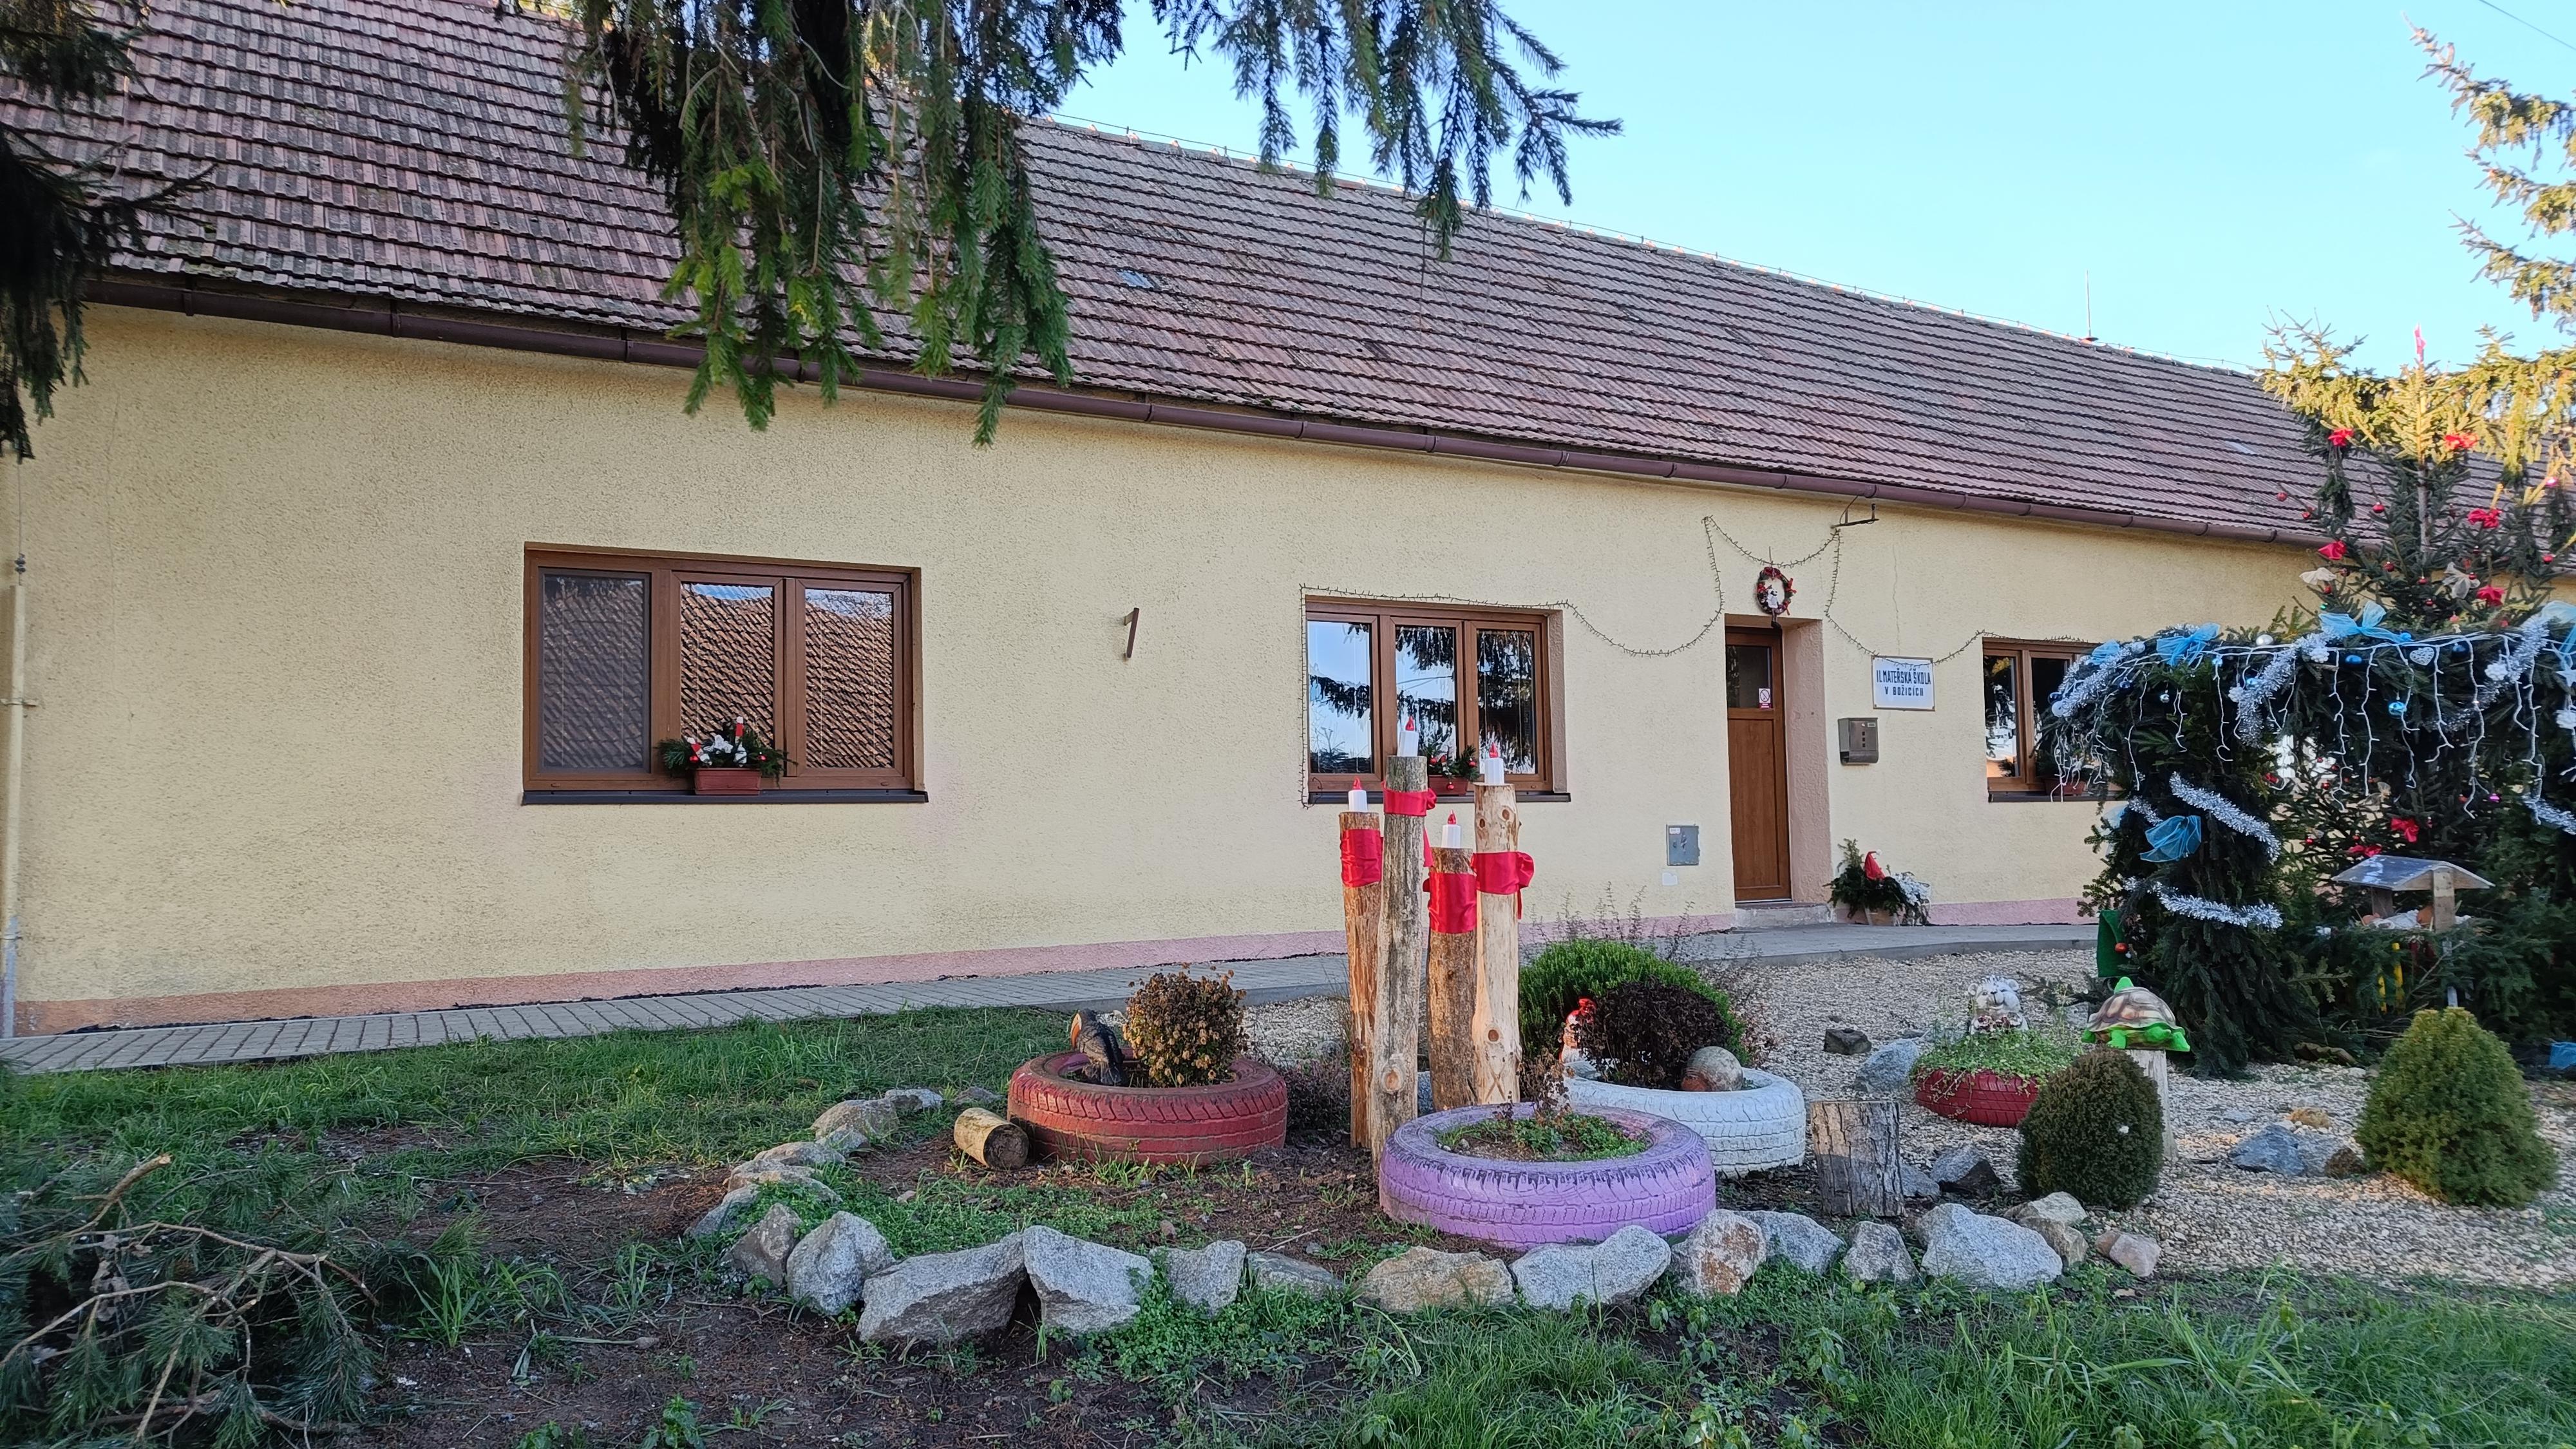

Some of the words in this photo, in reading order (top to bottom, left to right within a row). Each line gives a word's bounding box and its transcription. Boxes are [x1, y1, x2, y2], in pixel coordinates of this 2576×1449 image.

[1883, 668, 1912, 684] MATEŘSKÁ
[1913, 668, 1931, 685] ŠKOLA
[1884, 687, 1889, 695] V
[1893, 685, 1924, 696] BOŽICÍCH
